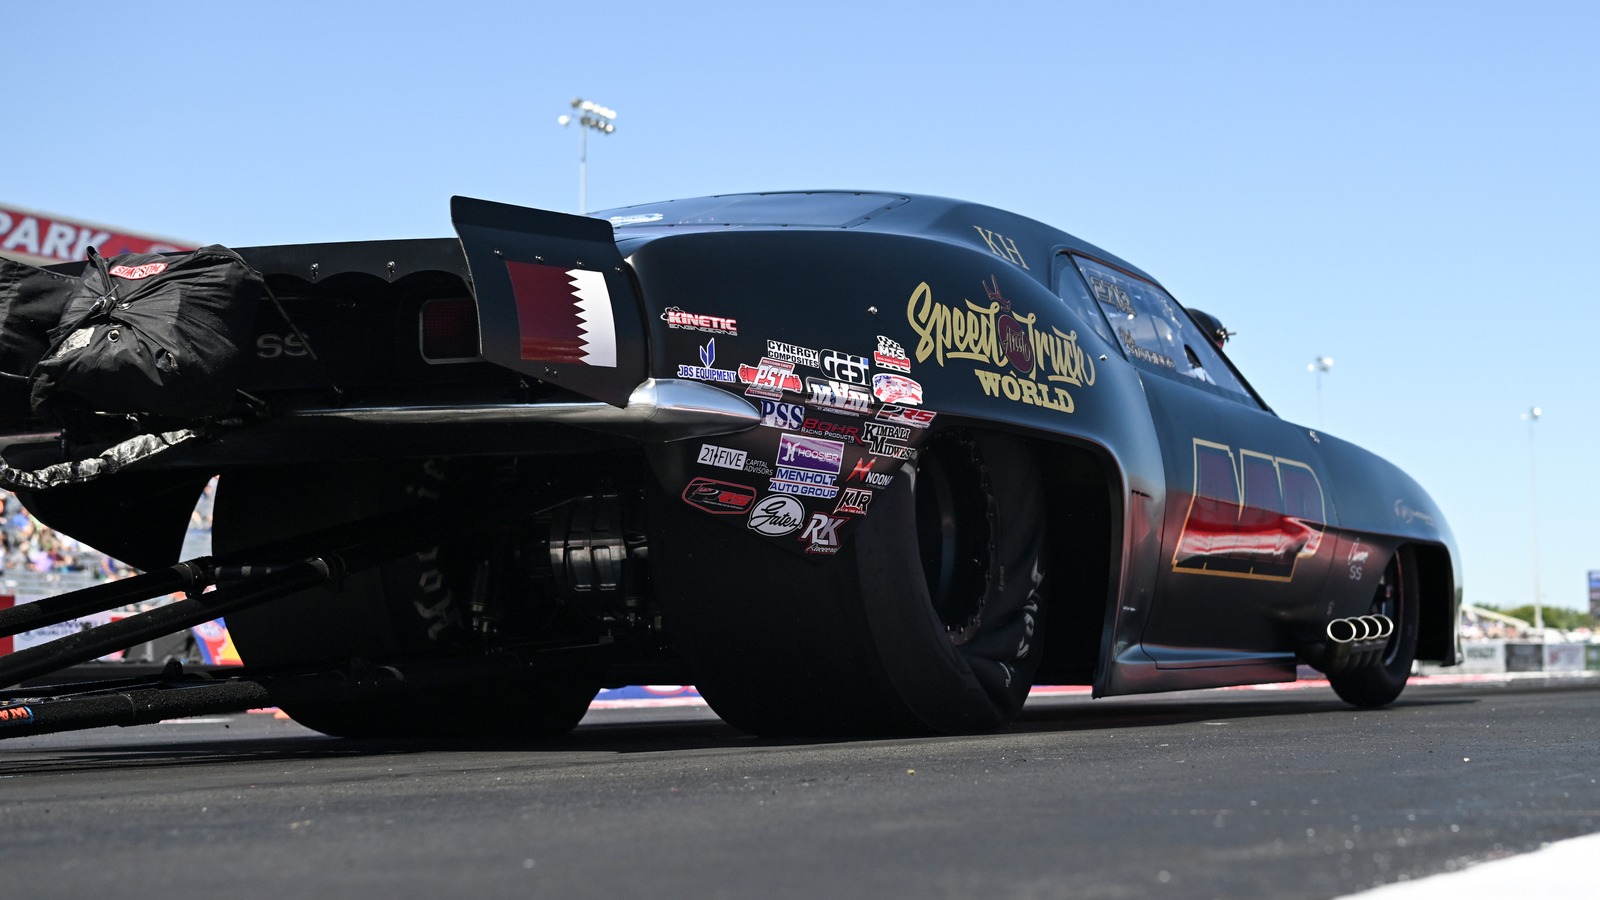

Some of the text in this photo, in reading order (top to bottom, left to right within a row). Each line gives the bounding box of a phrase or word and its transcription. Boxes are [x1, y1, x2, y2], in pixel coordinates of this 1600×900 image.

[973, 225, 1030, 271] KH
[115, 264, 161, 278] SIMPSON
[668, 311, 738, 332] KINETIC
[669, 323, 738, 336] ENGINEERING
[907, 281, 1009, 367] Speed
[1011, 311, 1096, 387] Truck
[256, 333, 310, 358] SS
[768, 340, 818, 360] CYNERGY
[768, 350, 819, 369] COMPOSITES
[677, 364, 737, 384] JBS EQUIPMENT
[752, 364, 793, 392] PST
[974, 369, 1075, 414] WORLD
[761, 400, 804, 429] PSS
[803, 417, 864, 446] BOHR
[745, 458, 769, 469] CAPITAL
[798, 448, 839, 463] HOOSIER
[743, 464, 773, 476] ADVISORS
[776, 467, 837, 487] MENHOLT
[769, 482, 837, 499] AUTO GROUP
[751, 501, 803, 529] Gates
[800, 513, 845, 546] RK
[1348, 565, 1363, 581] SS
